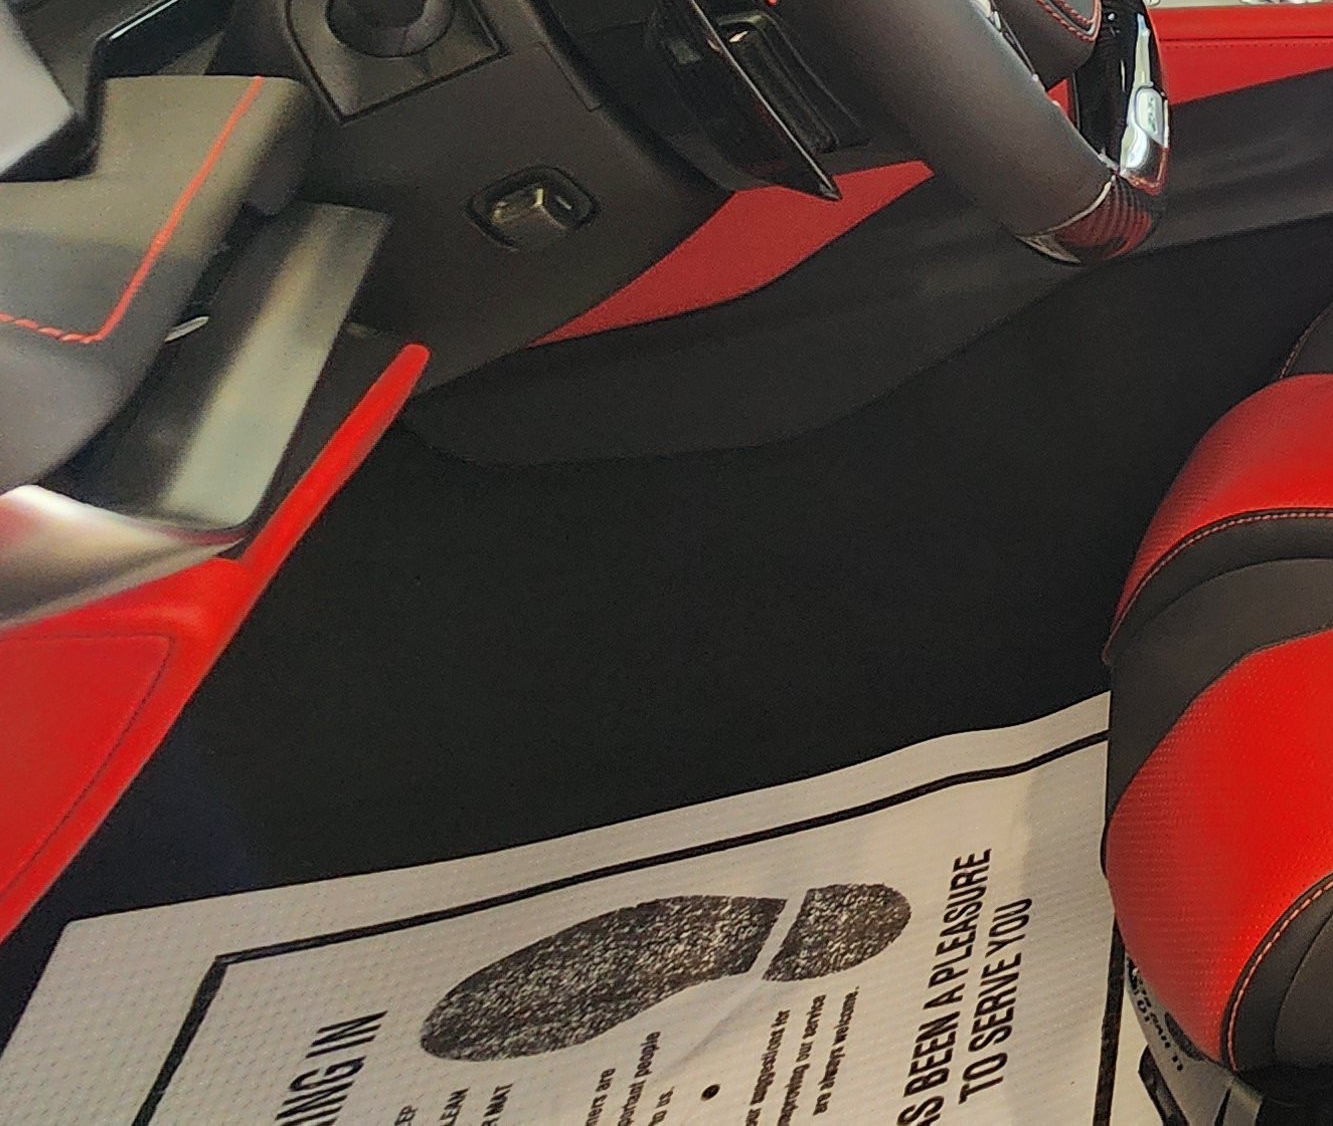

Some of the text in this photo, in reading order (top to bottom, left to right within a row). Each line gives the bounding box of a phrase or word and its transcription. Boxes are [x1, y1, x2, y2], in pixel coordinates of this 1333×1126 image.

[927, 847, 993, 989] PLEASURE
[802, 994, 828, 1040] service
[922, 981, 966, 1012] A
[957, 898, 1033, 1106] TO SERVE YOU
[275, 1010, 389, 1126] ING IN
[634, 1031, 661, 1078] people
[749, 1027, 786, 1106] suggestions
[770, 1009, 791, 1027] for
[796, 1040, 814, 1063] our
[812, 985, 860, 1116] are always welcome.
[902, 1010, 962, 1098] BEEN
[484, 1082, 515, 1117] MAT
[595, 1068, 616, 1092] are
[656, 1086, 675, 1109] us.
